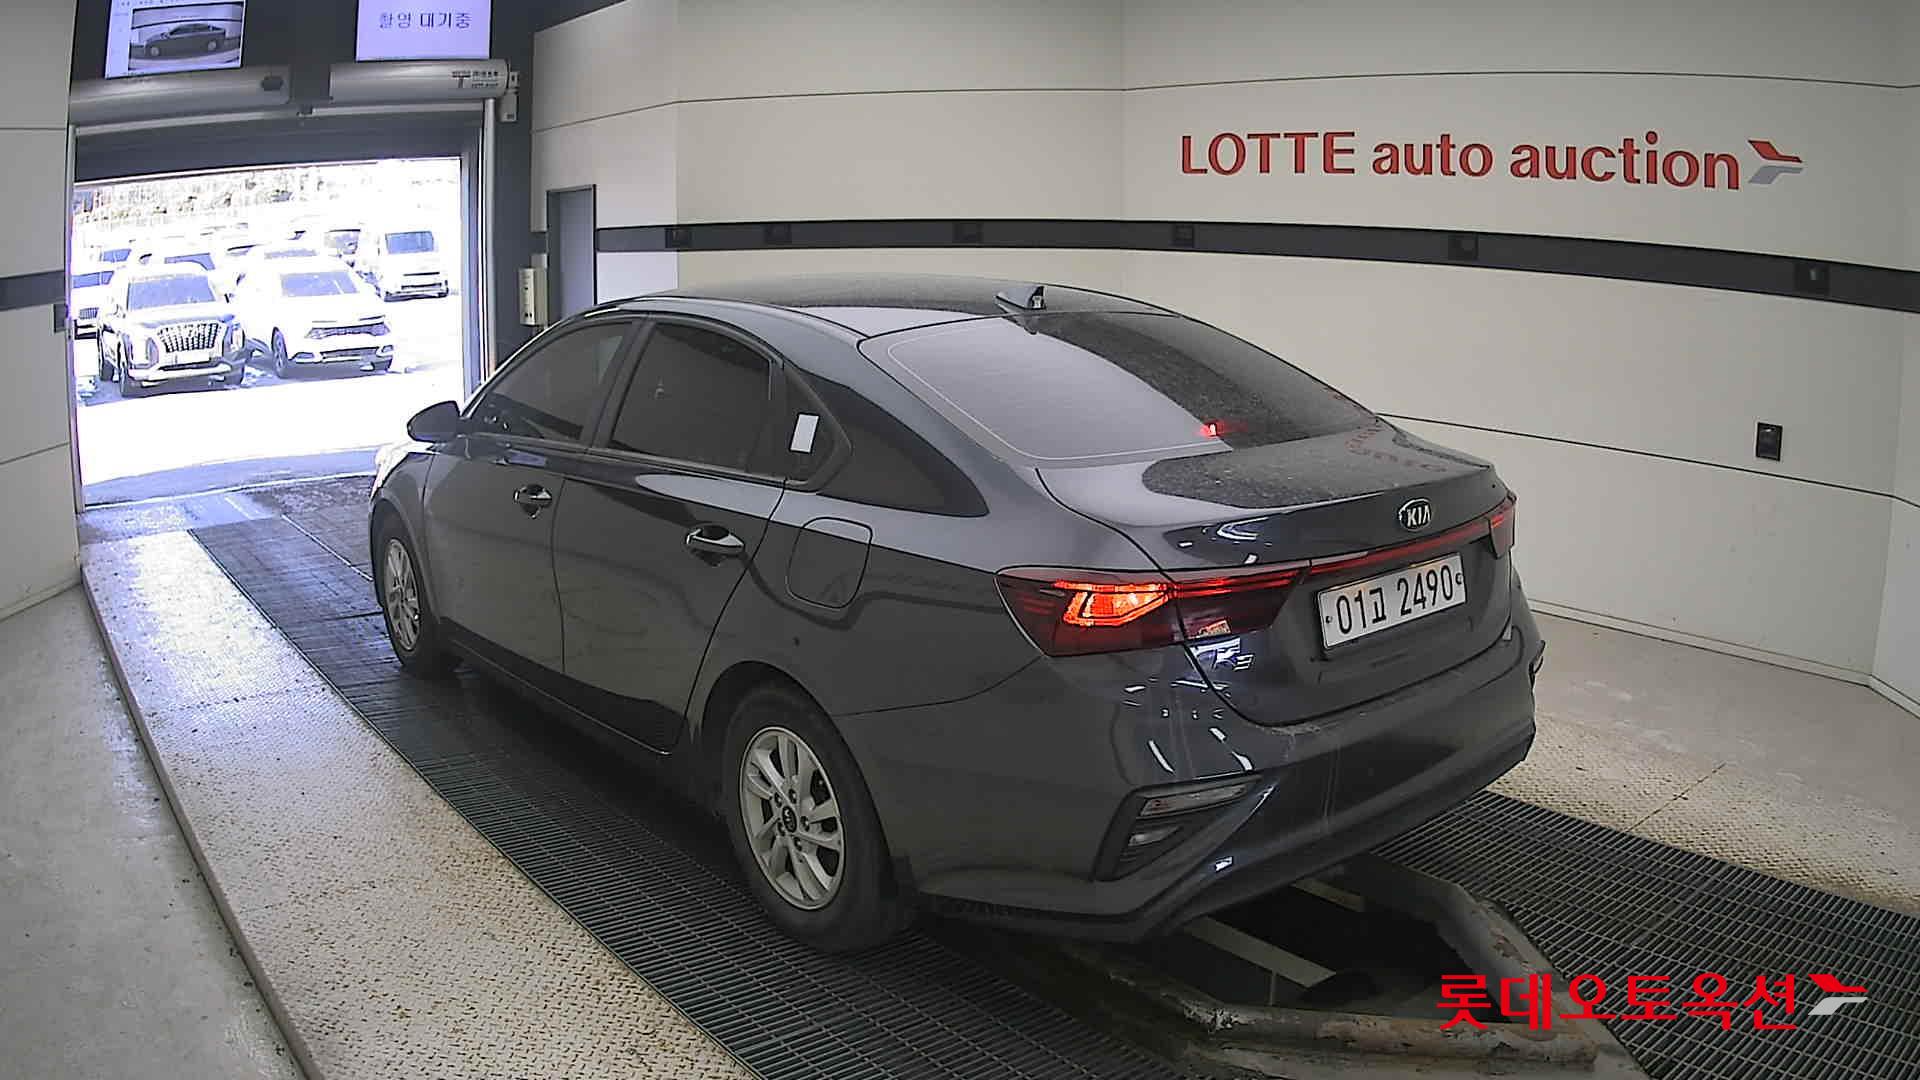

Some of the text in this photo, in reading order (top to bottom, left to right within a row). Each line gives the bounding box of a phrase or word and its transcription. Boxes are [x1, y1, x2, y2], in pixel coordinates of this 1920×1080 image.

[419, 11, 473, 30] 대기중
[1181, 130, 1740, 190] LOTTE auto auction
[1405, 503, 1433, 529] KIA
[1396, 564, 1454, 617] 2490
